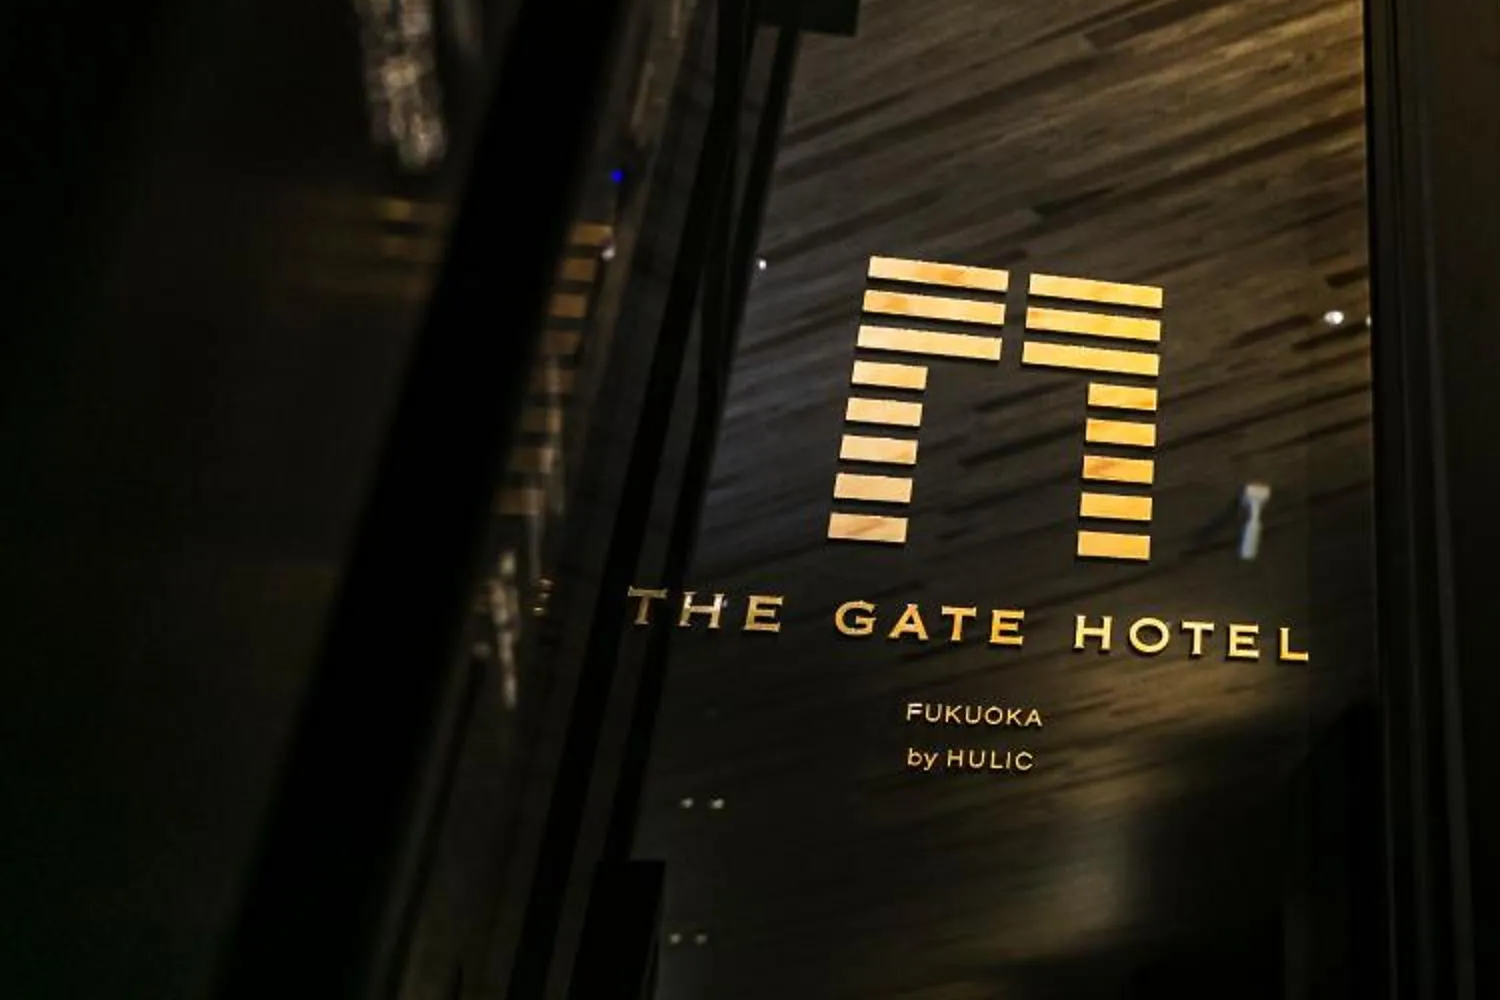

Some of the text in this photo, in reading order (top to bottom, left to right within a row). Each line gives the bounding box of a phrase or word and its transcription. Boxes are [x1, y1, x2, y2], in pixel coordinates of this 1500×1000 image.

[627, 585, 1311, 664] THE GATE HOTEL
[905, 703, 1044, 729] FUKUOKA
[906, 746, 1034, 772] by HULIC
